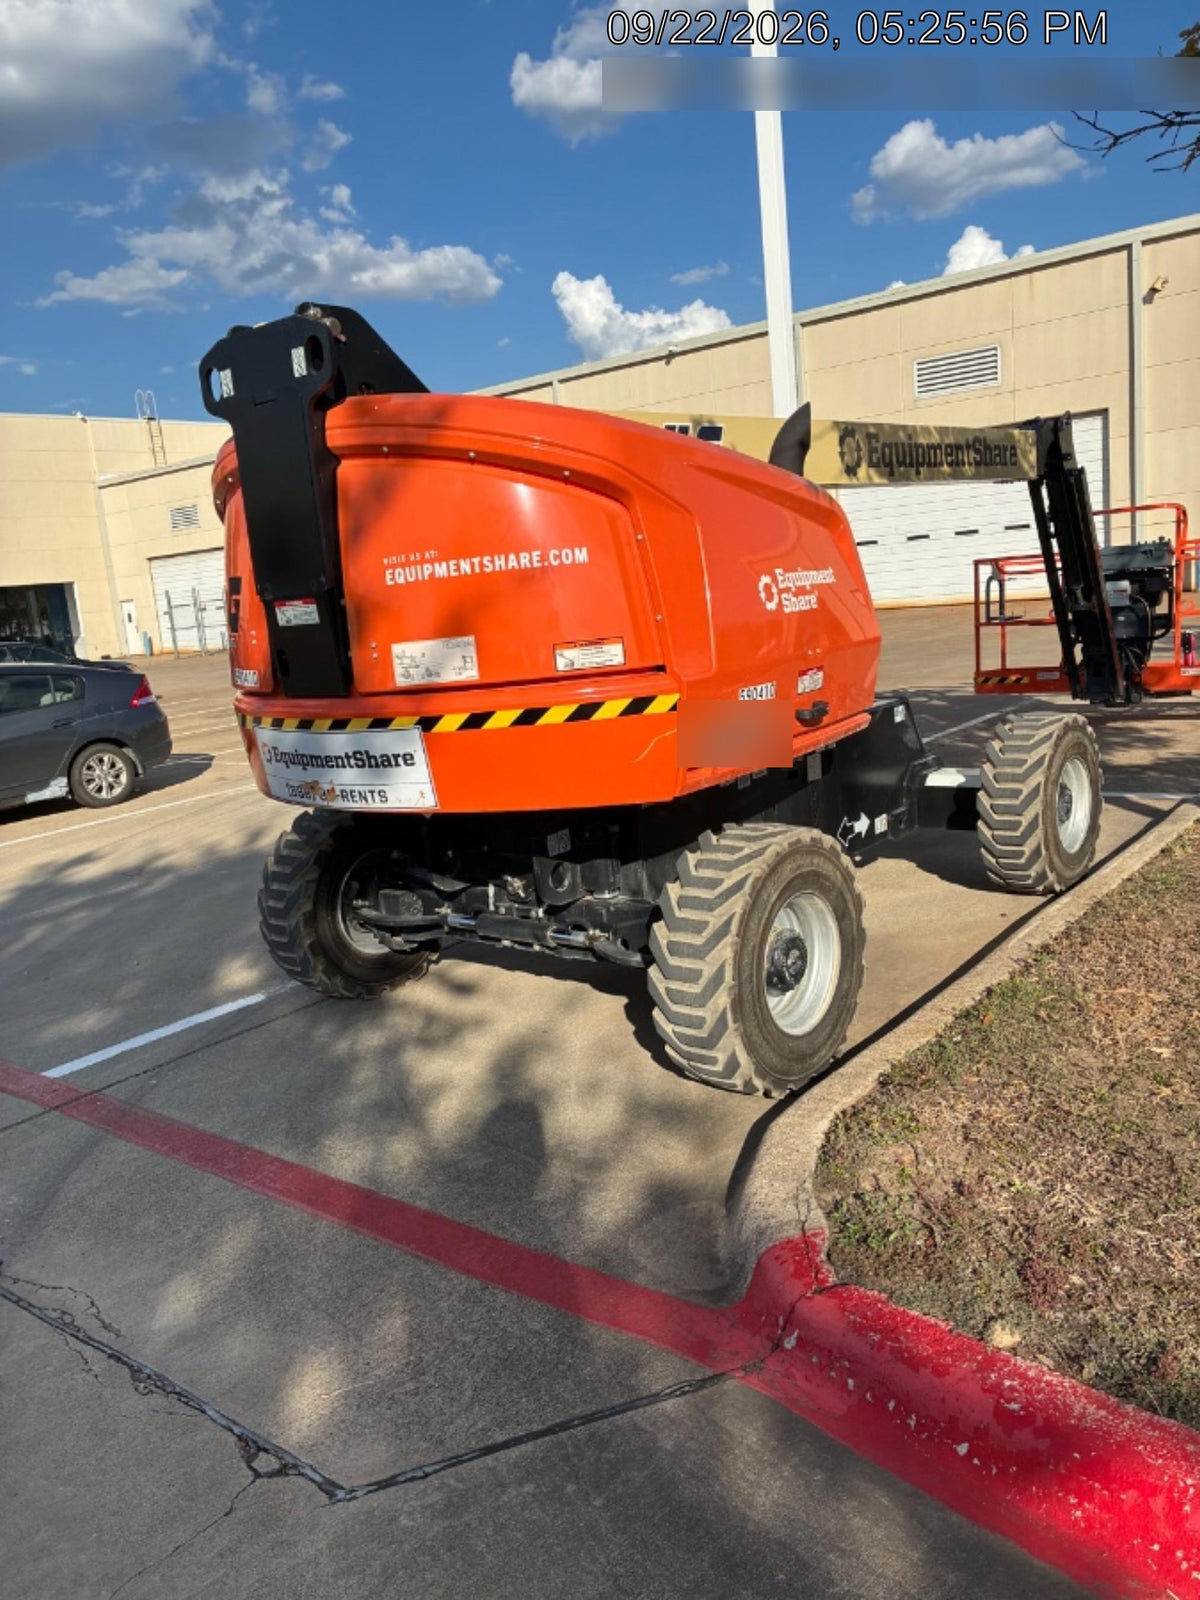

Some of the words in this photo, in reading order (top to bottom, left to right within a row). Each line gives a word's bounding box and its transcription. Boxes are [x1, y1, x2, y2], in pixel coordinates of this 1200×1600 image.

[866, 432, 1019, 476] EquipmentShare
[385, 547, 589, 586] EQUIPMENTSHARE.COM
[774, 566, 836, 592] Equipment
[781, 592, 818, 614] Share
[271, 746, 416, 770] EquipmentShare
